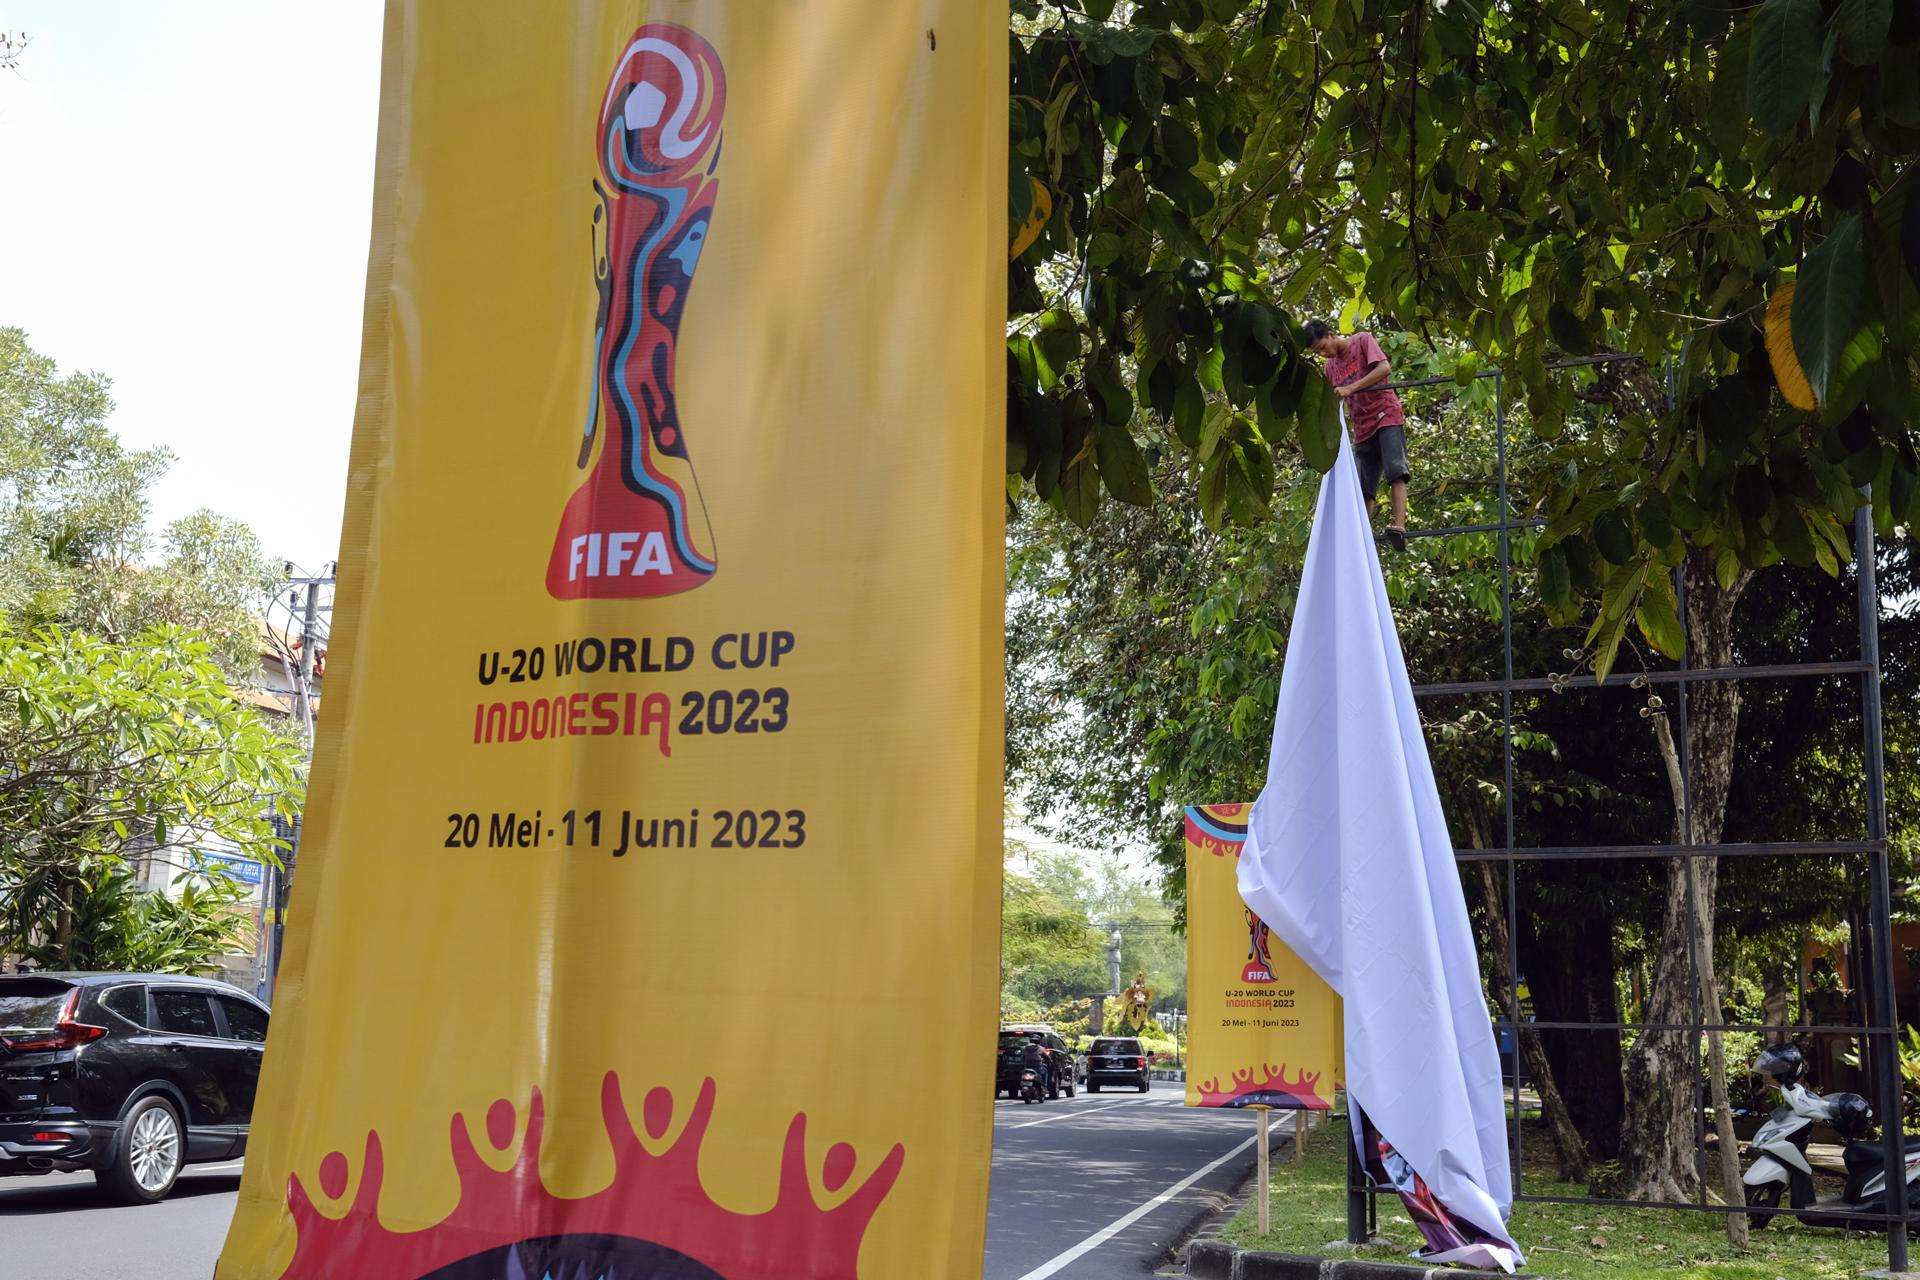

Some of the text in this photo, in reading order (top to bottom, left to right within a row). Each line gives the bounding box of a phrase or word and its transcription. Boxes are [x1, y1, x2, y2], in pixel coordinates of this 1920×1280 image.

[568, 531, 673, 582] FIFA
[477, 630, 796, 686] U-20 WORLD CUP
[473, 687, 789, 758] INDONESIA 2023
[444, 813, 480, 848] 20
[488, 810, 542, 848] Mei
[561, 809, 601, 847] 11
[612, 808, 700, 858] Juni
[710, 809, 806, 848] 2023
[1248, 971, 1270, 980] FIFA
[1225, 999, 1295, 1011] INDONESIA 2023
[1262, 1020, 1279, 1028] Juni
